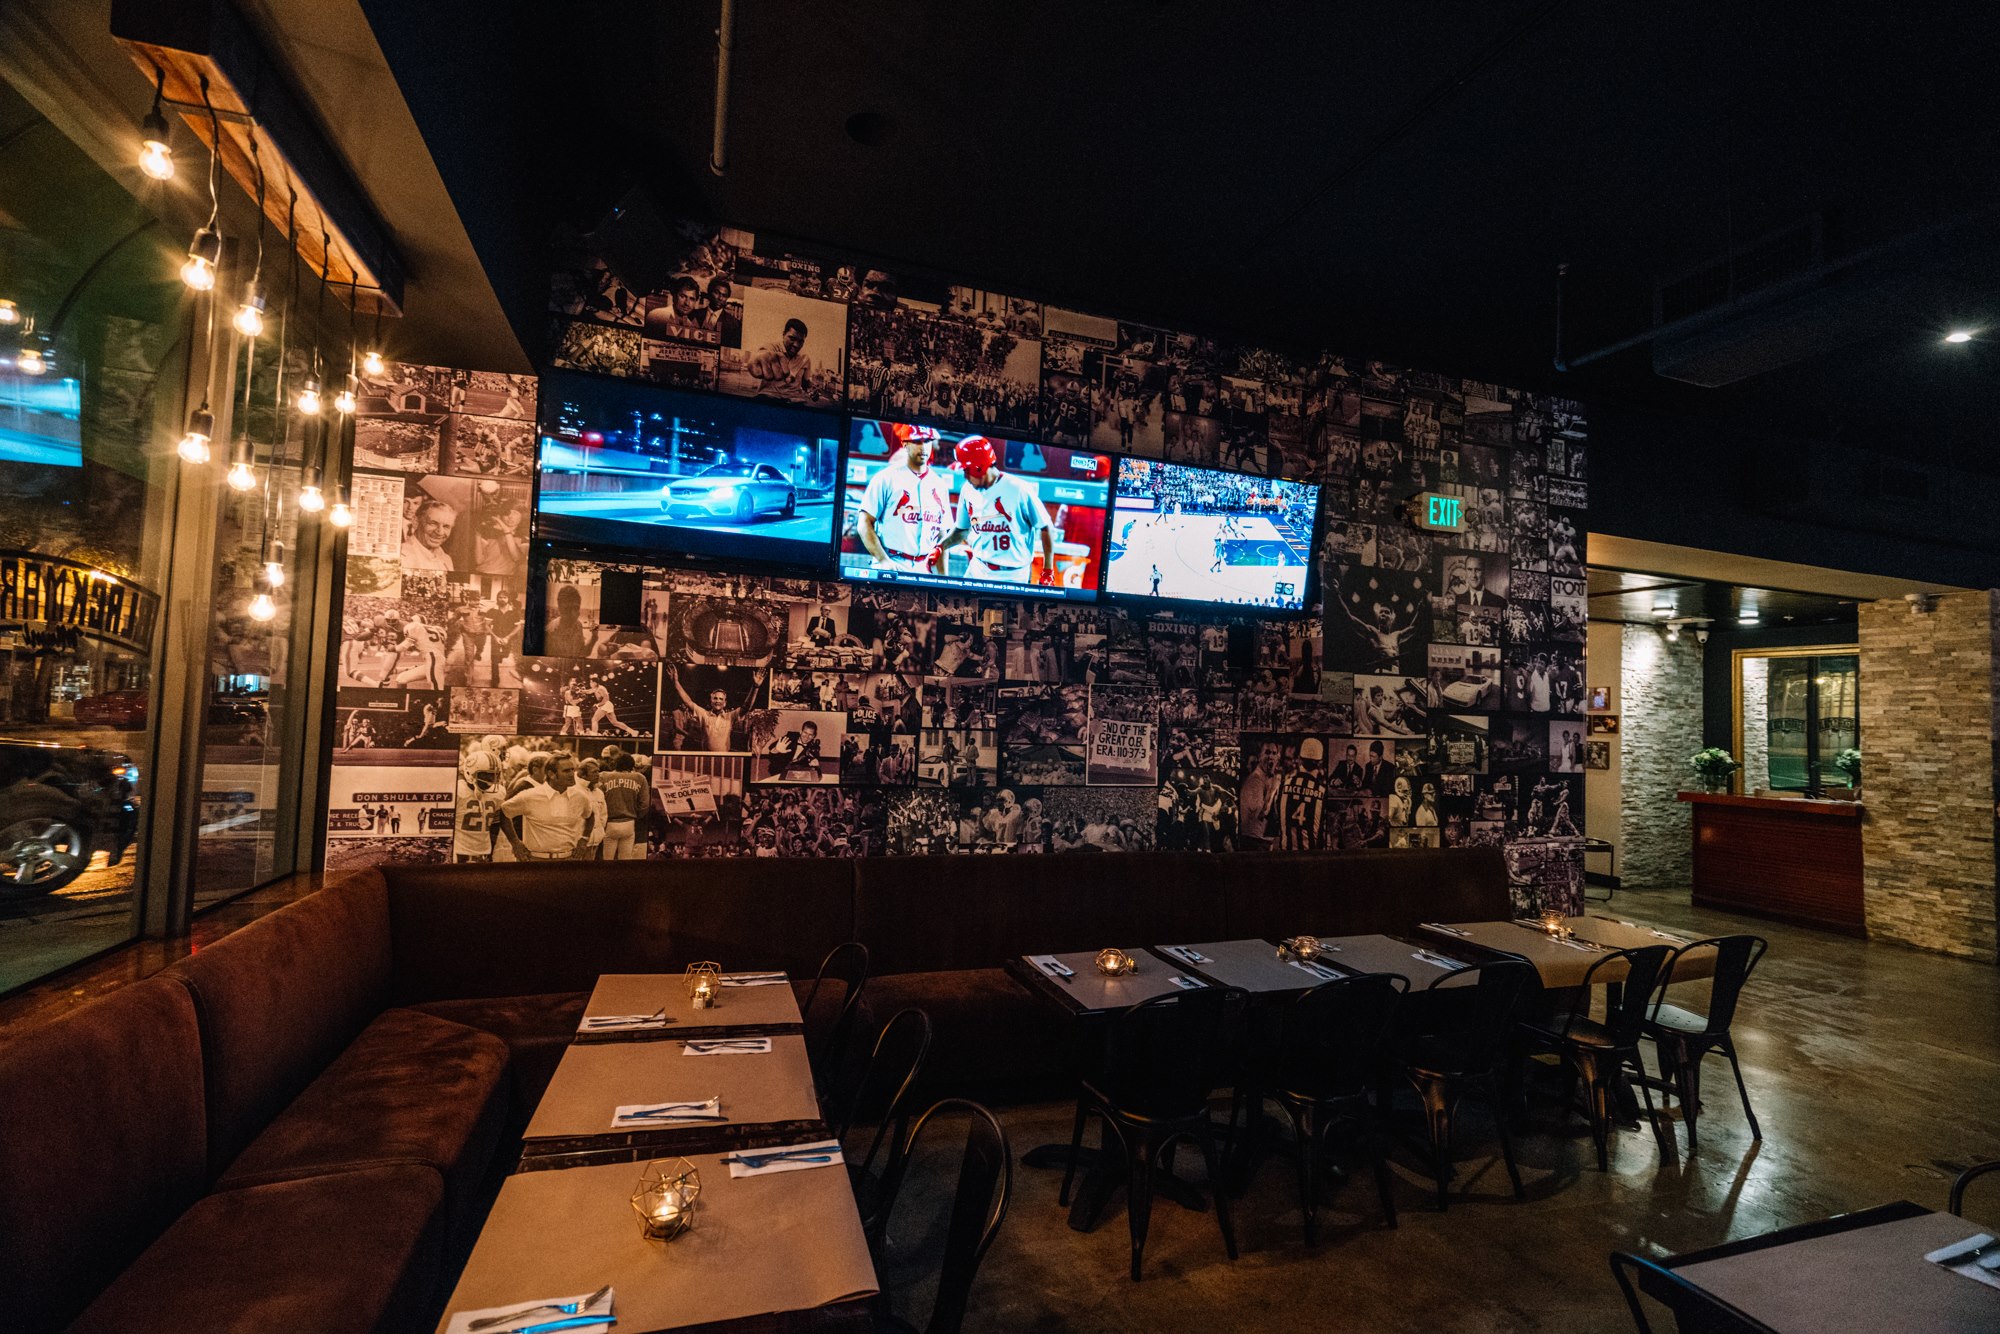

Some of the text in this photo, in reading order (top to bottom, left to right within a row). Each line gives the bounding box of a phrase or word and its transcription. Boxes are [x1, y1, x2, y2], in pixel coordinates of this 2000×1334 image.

[670, 325, 717, 343] VICE
[1429, 496, 1460, 527] EXIT
[992, 534, 1011, 551] 18
[1553, 579, 1586, 597] SPORT
[1148, 622, 1196, 635] BOXING
[852, 709, 878, 720] POLICE
[1102, 721, 1148, 736] END OF THE
[1098, 732, 1127, 746] GREAT
[1096, 744, 1116, 757] ERA:
[356, 794, 378, 802] DON
[383, 794, 418, 802] SHULA
[678, 788, 710, 798] DOLPHINS
[1291, 801, 1307, 826] 4
